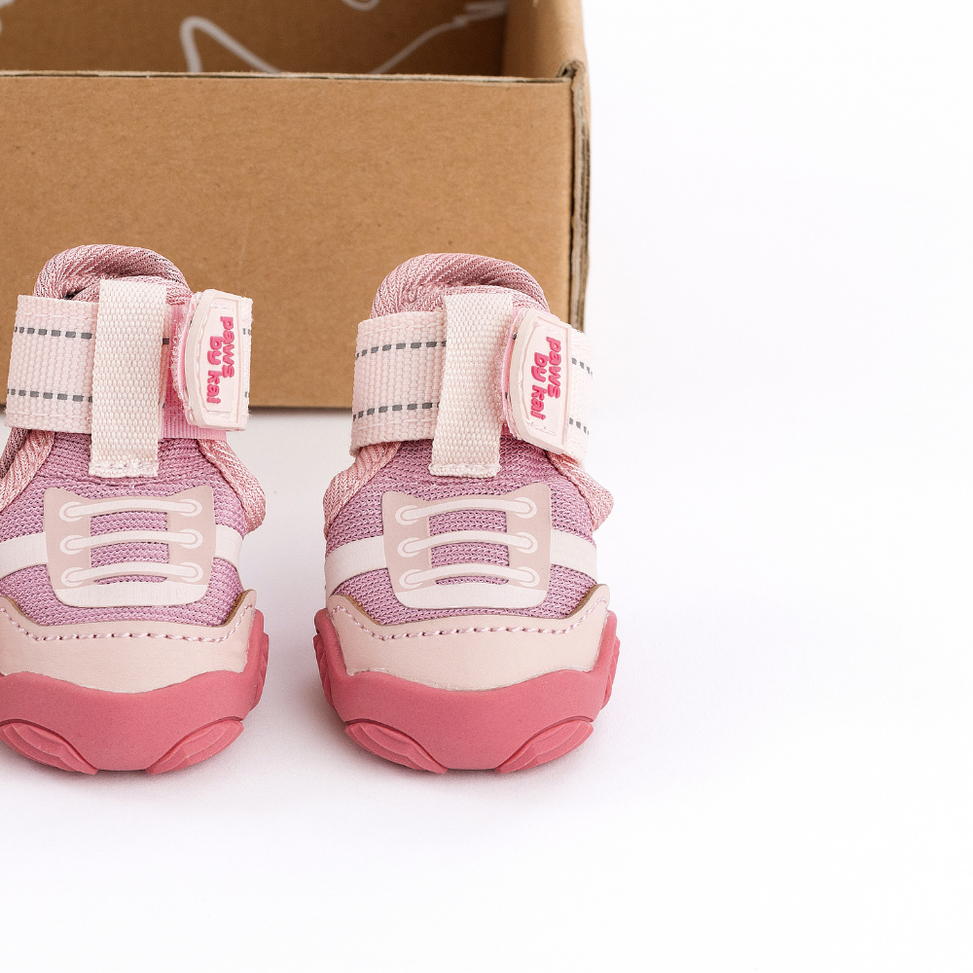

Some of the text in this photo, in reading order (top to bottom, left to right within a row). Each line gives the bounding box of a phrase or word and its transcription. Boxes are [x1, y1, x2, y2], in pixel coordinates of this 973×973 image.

[206, 335, 223, 404] by kai
[220, 316, 235, 378] paws
[546, 336, 561, 399] paws
[530, 352, 549, 420] by kai
